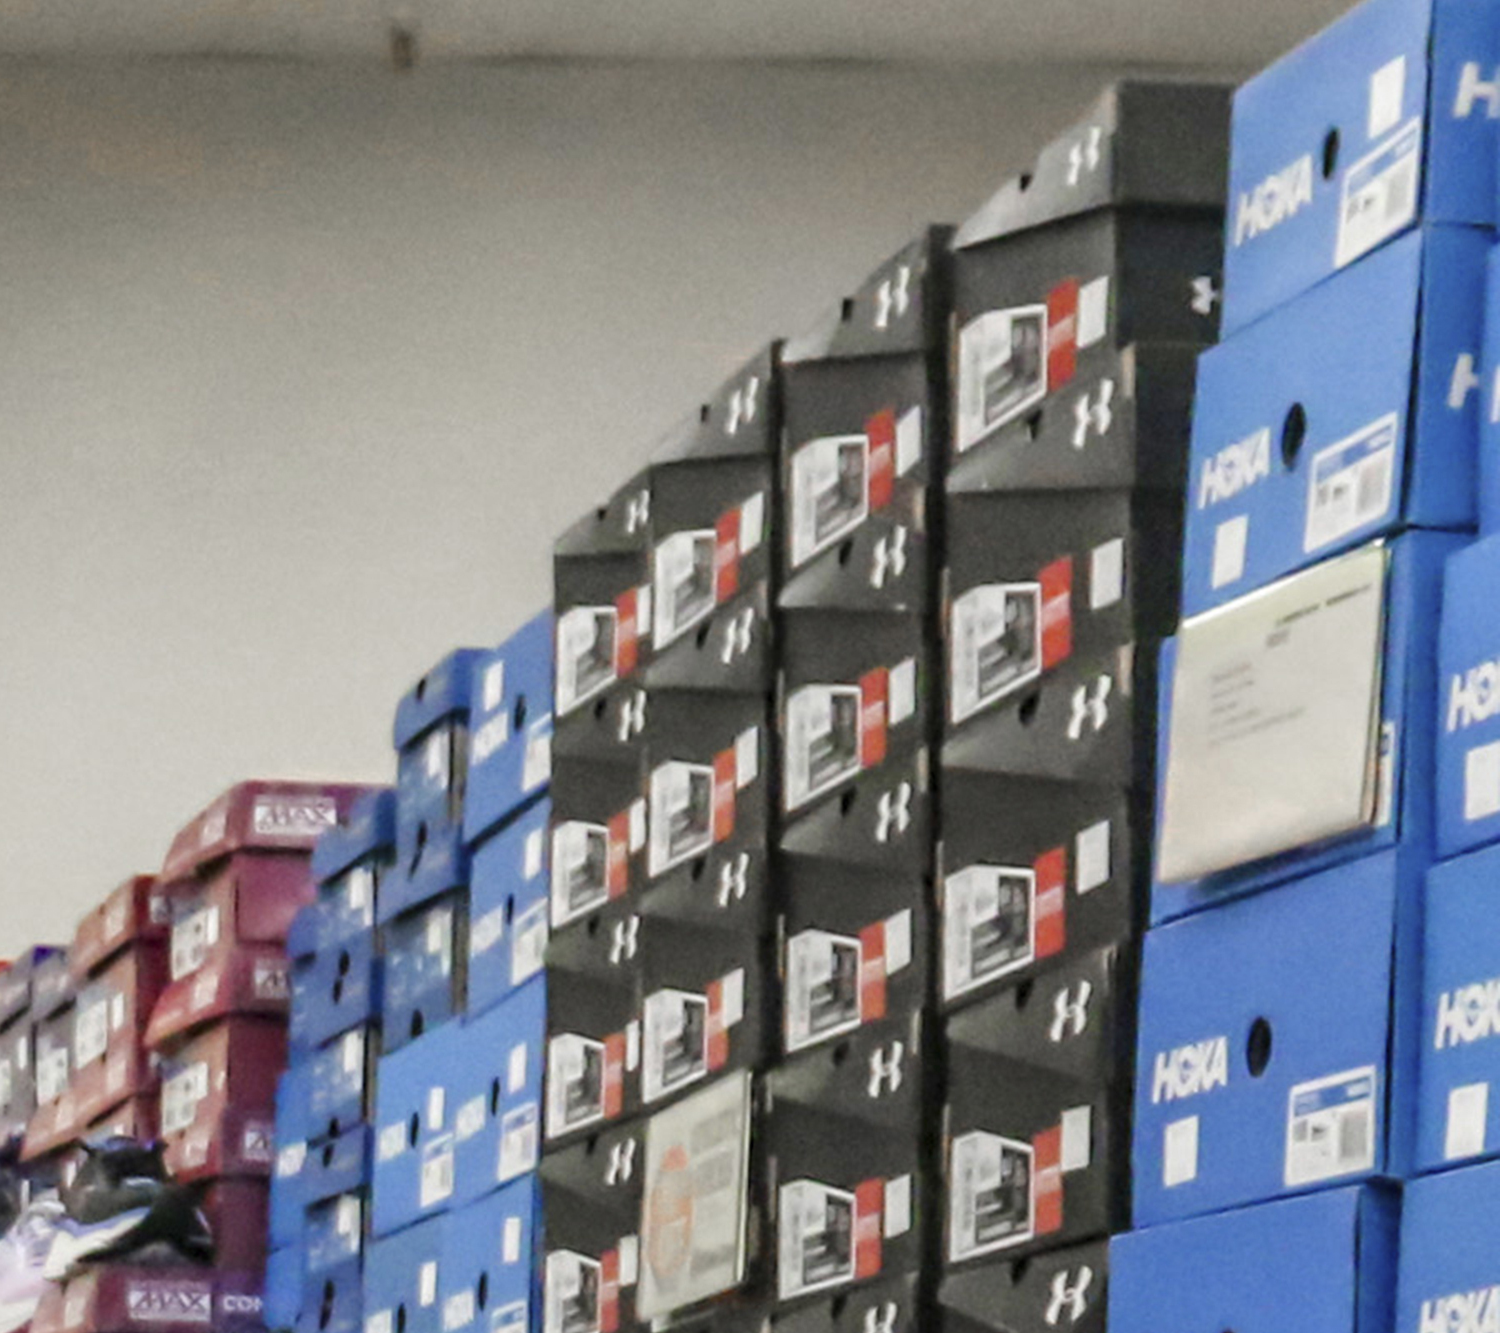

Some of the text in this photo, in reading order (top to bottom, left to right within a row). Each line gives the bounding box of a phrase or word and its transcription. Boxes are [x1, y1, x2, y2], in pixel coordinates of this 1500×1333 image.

[1235, 154, 1313, 245] HOKA
[1198, 428, 1270, 509] HOKA
[1447, 660, 1500, 731] HO
[1152, 1037, 1227, 1103] HOKA
